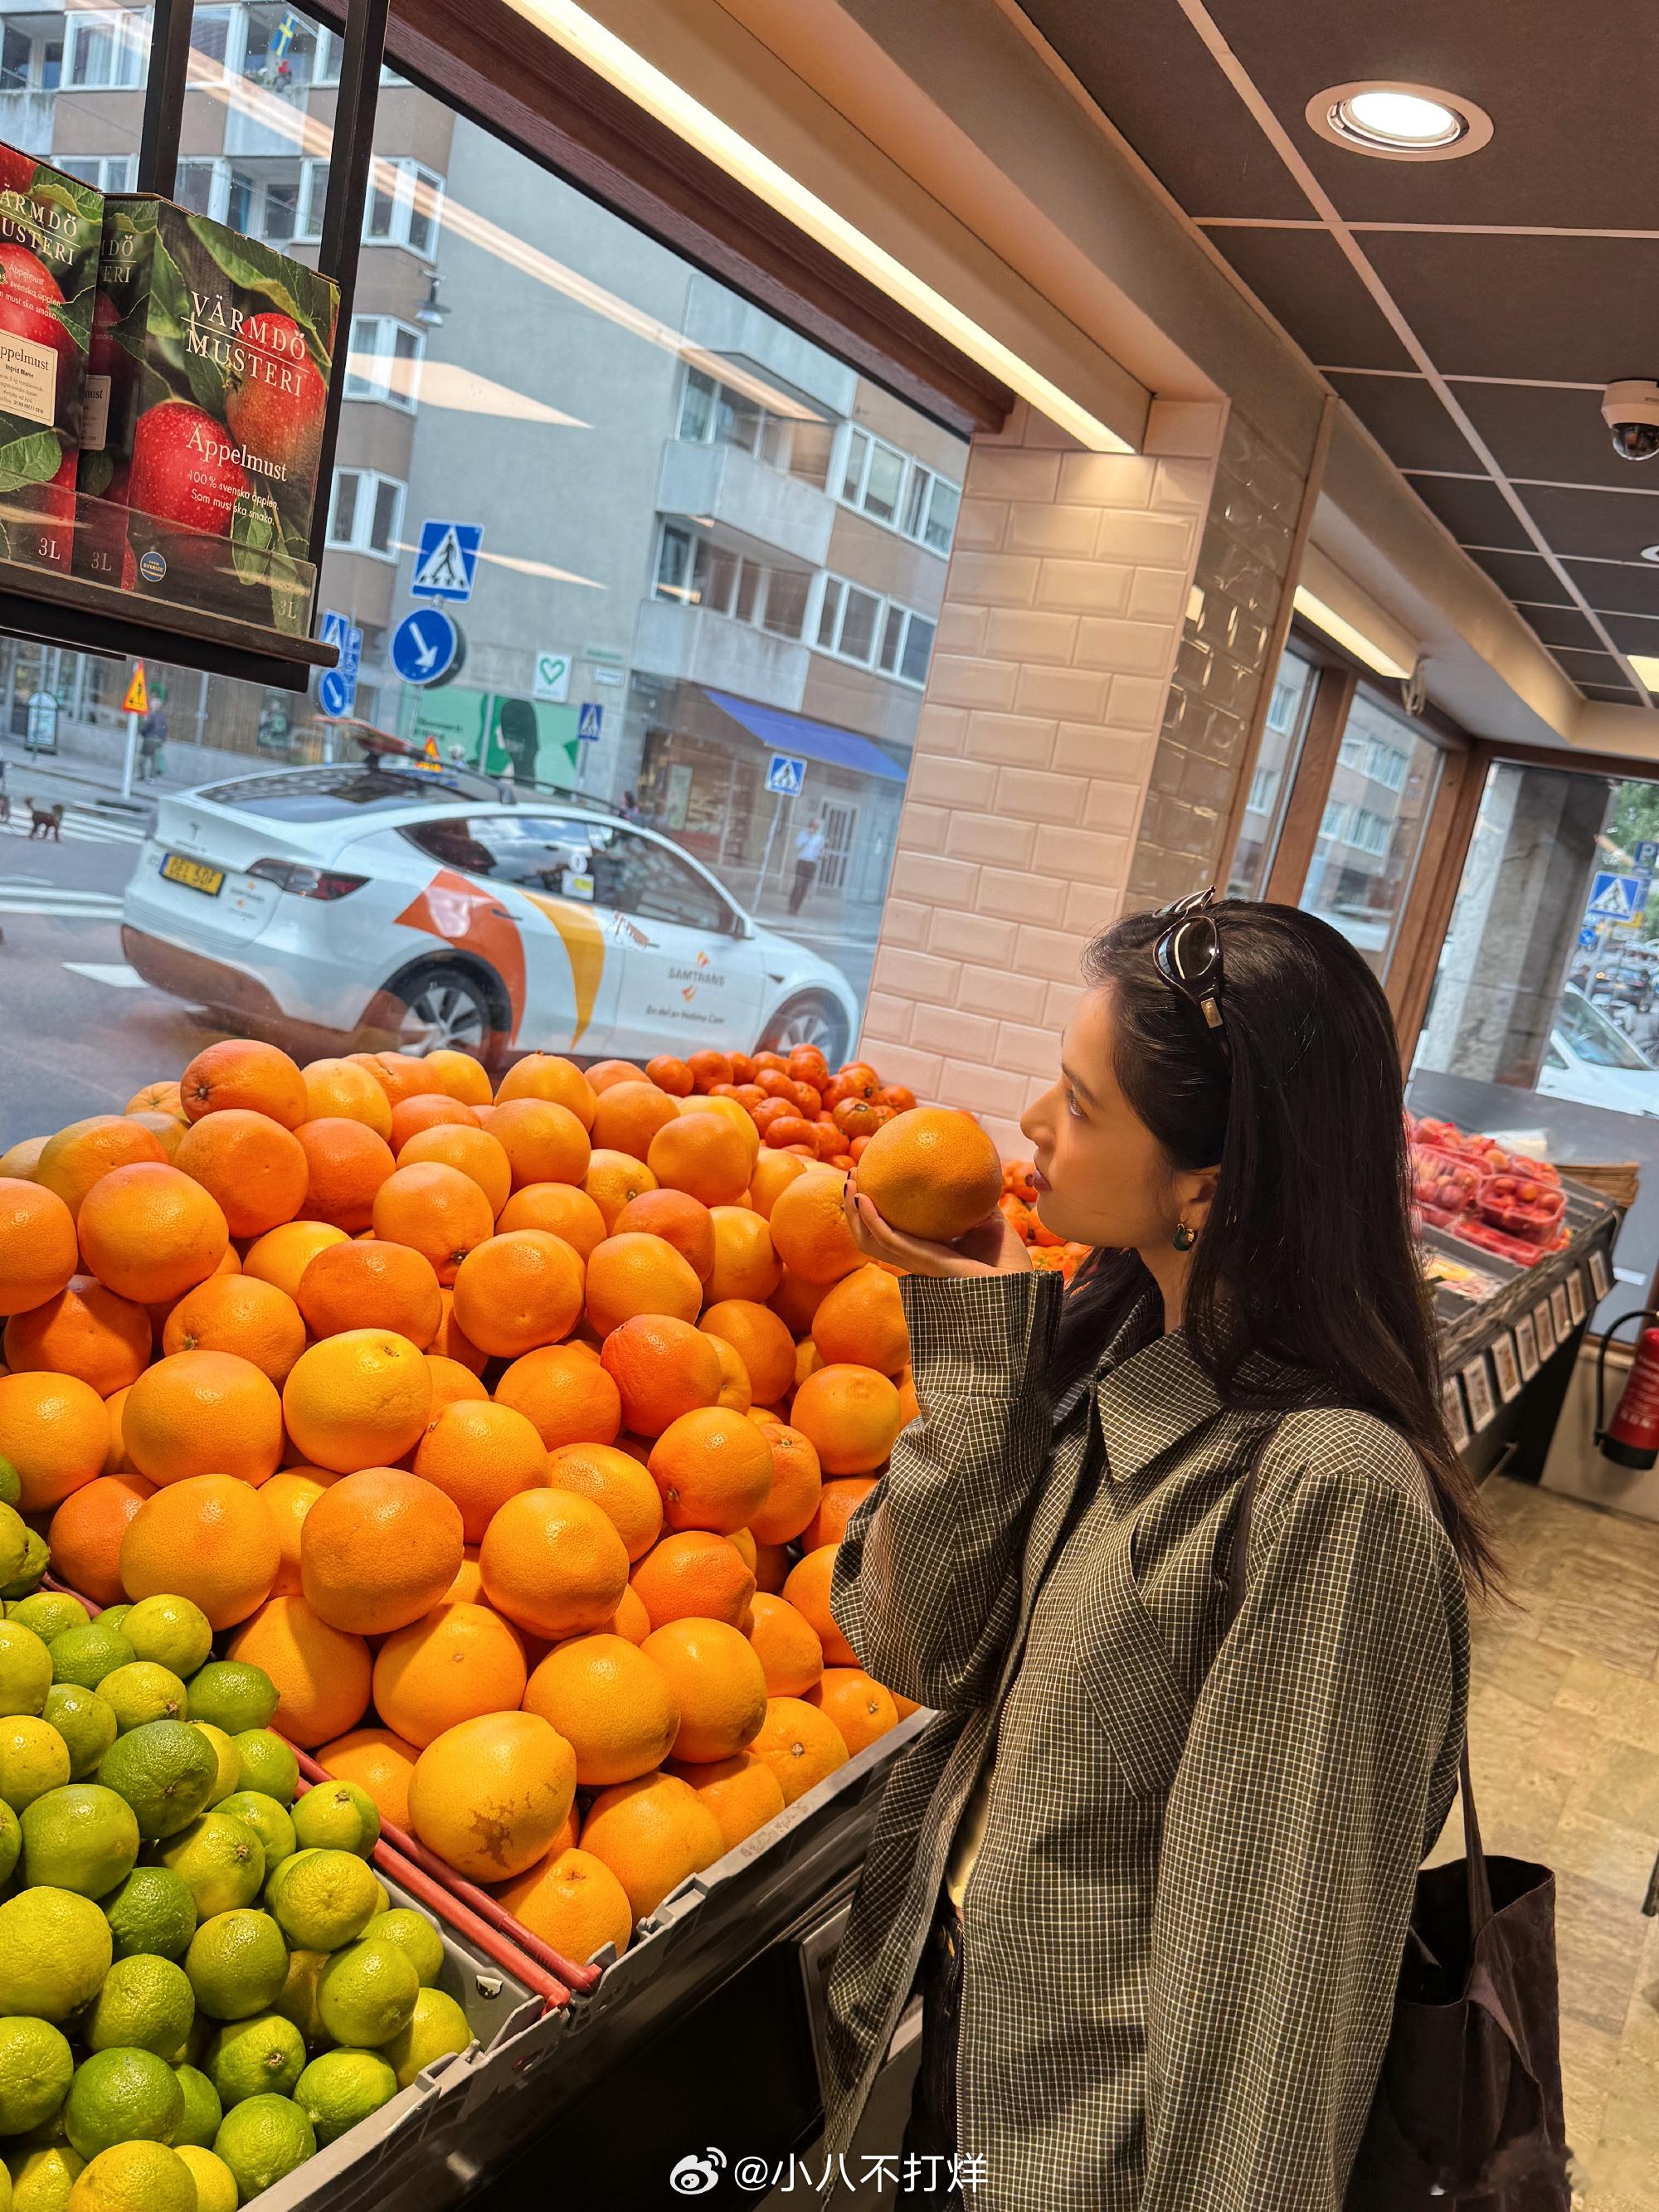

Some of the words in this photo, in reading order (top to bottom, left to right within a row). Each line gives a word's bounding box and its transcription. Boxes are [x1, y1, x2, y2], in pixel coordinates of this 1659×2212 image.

[0, 183, 77, 237] ÄRMDÖ
[2, 217, 75, 266] USTERI
[10, 281, 36, 298] svenska
[37, 290, 63, 309] äpplen.
[191, 290, 306, 360] VÄRMDÖ
[0, 346, 49, 371] ppelmust
[186, 328, 302, 397] MUSTERI
[186, 422, 287, 483] Äppelmust
[188, 469, 217, 489] 100%
[219, 483, 251, 499] svenska
[251, 490, 280, 510] äpplen.
[191, 489, 211, 504] Som
[212, 498, 231, 511] must
[233, 502, 247, 515] ska
[249, 510, 275, 526] smaka.
[38, 537, 61, 560] 3L
[90, 552, 112, 571] 3L
[277, 599, 296, 620] 3L
[668, 968, 725, 986] SAMTRANS
